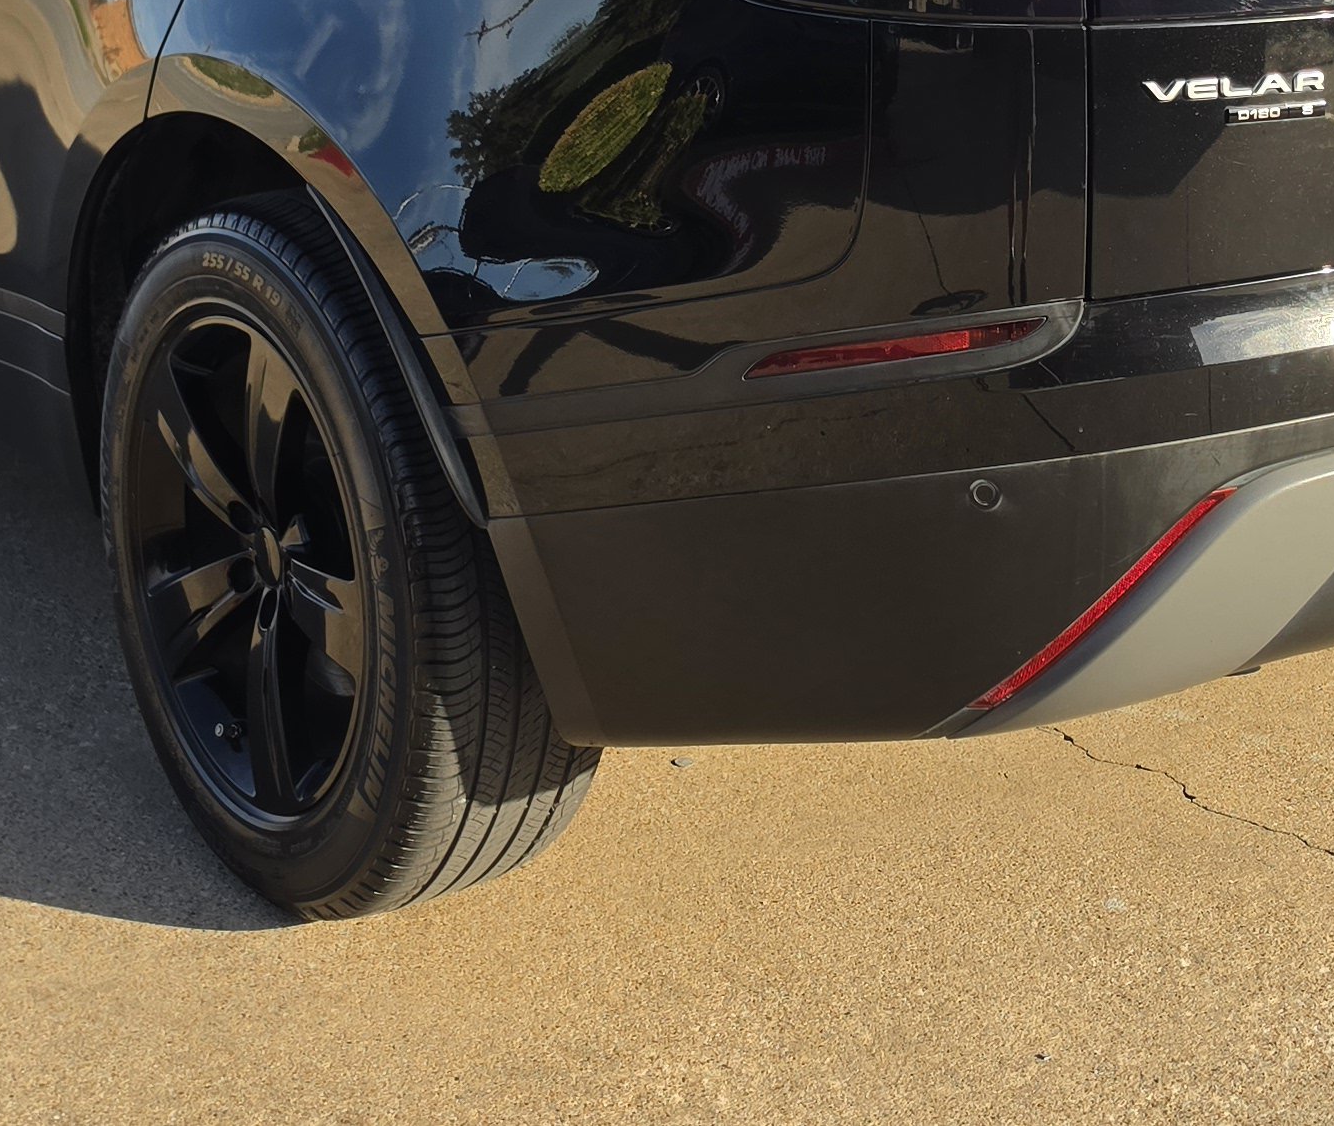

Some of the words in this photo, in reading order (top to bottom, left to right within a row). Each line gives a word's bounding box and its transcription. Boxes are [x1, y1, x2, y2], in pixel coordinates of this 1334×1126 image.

[1141, 69, 1325, 103] VELAR
[1237, 107, 1280, 120] D180
[363, 589, 397, 811] MICHELIN
